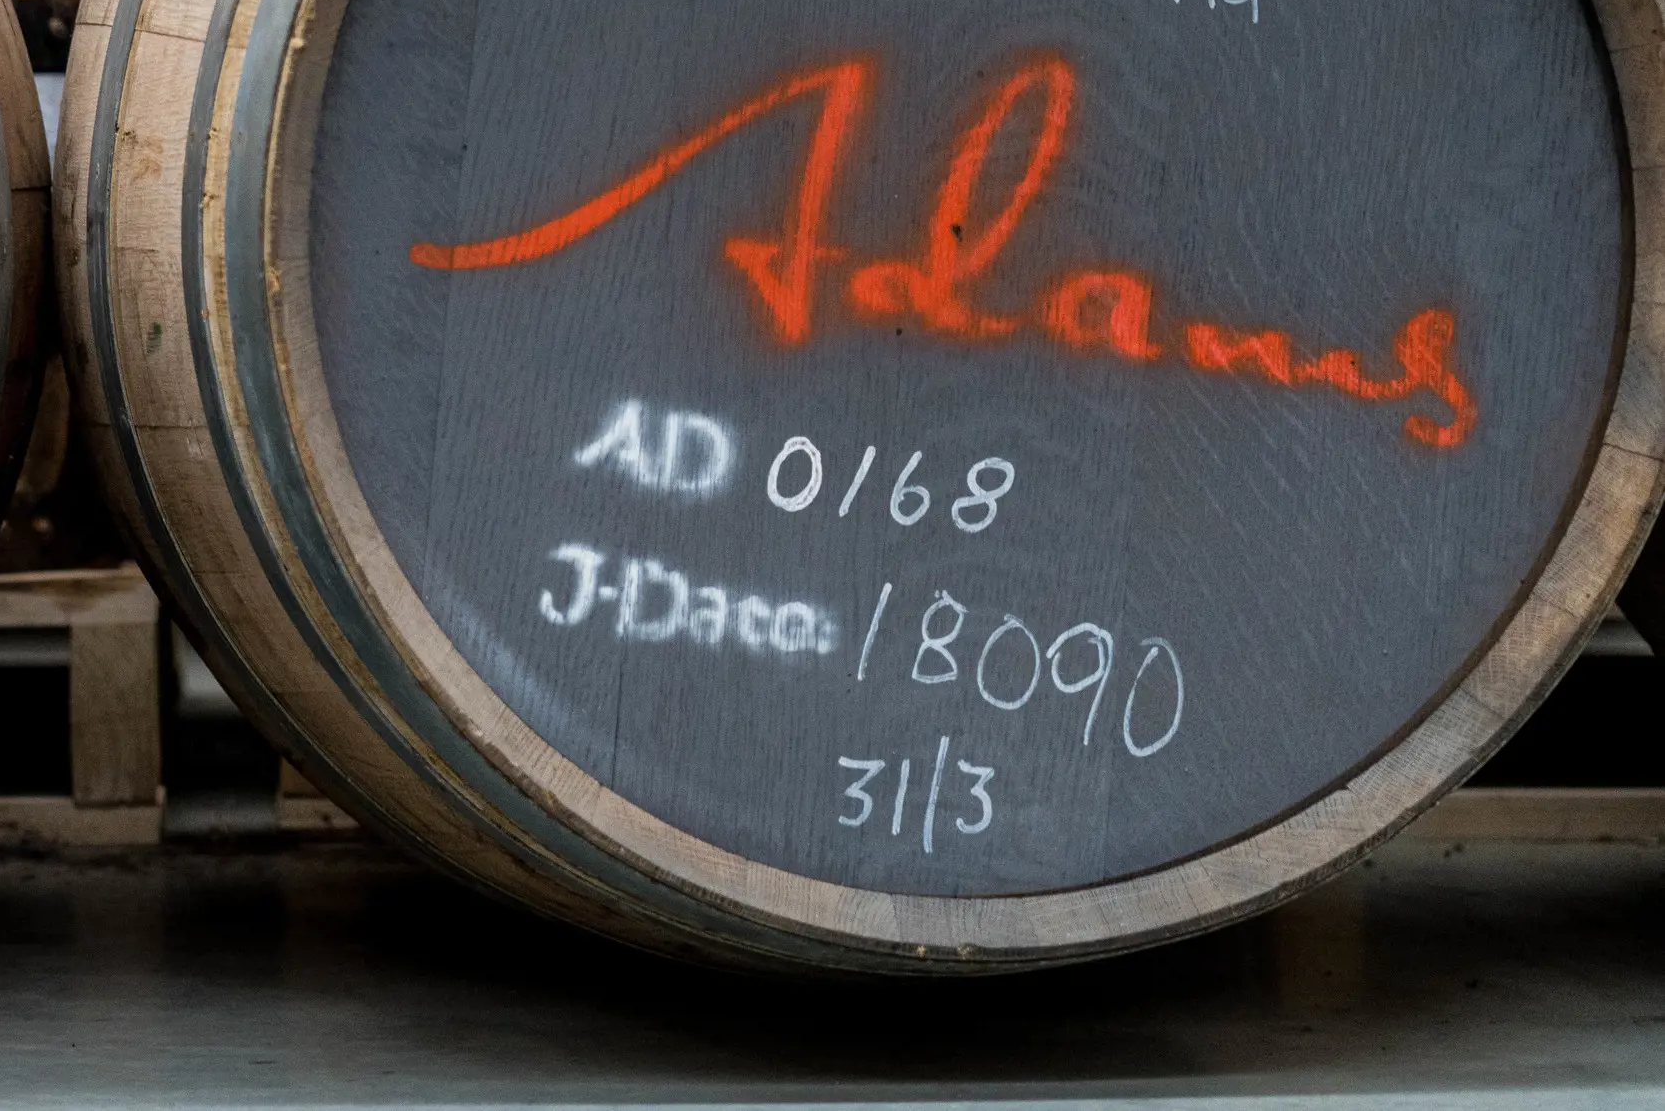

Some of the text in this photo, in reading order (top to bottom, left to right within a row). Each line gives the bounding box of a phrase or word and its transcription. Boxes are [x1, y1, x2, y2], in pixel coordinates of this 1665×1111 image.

[573, 398, 1016, 534] AD 0168
[856, 581, 1185, 758] 18090
